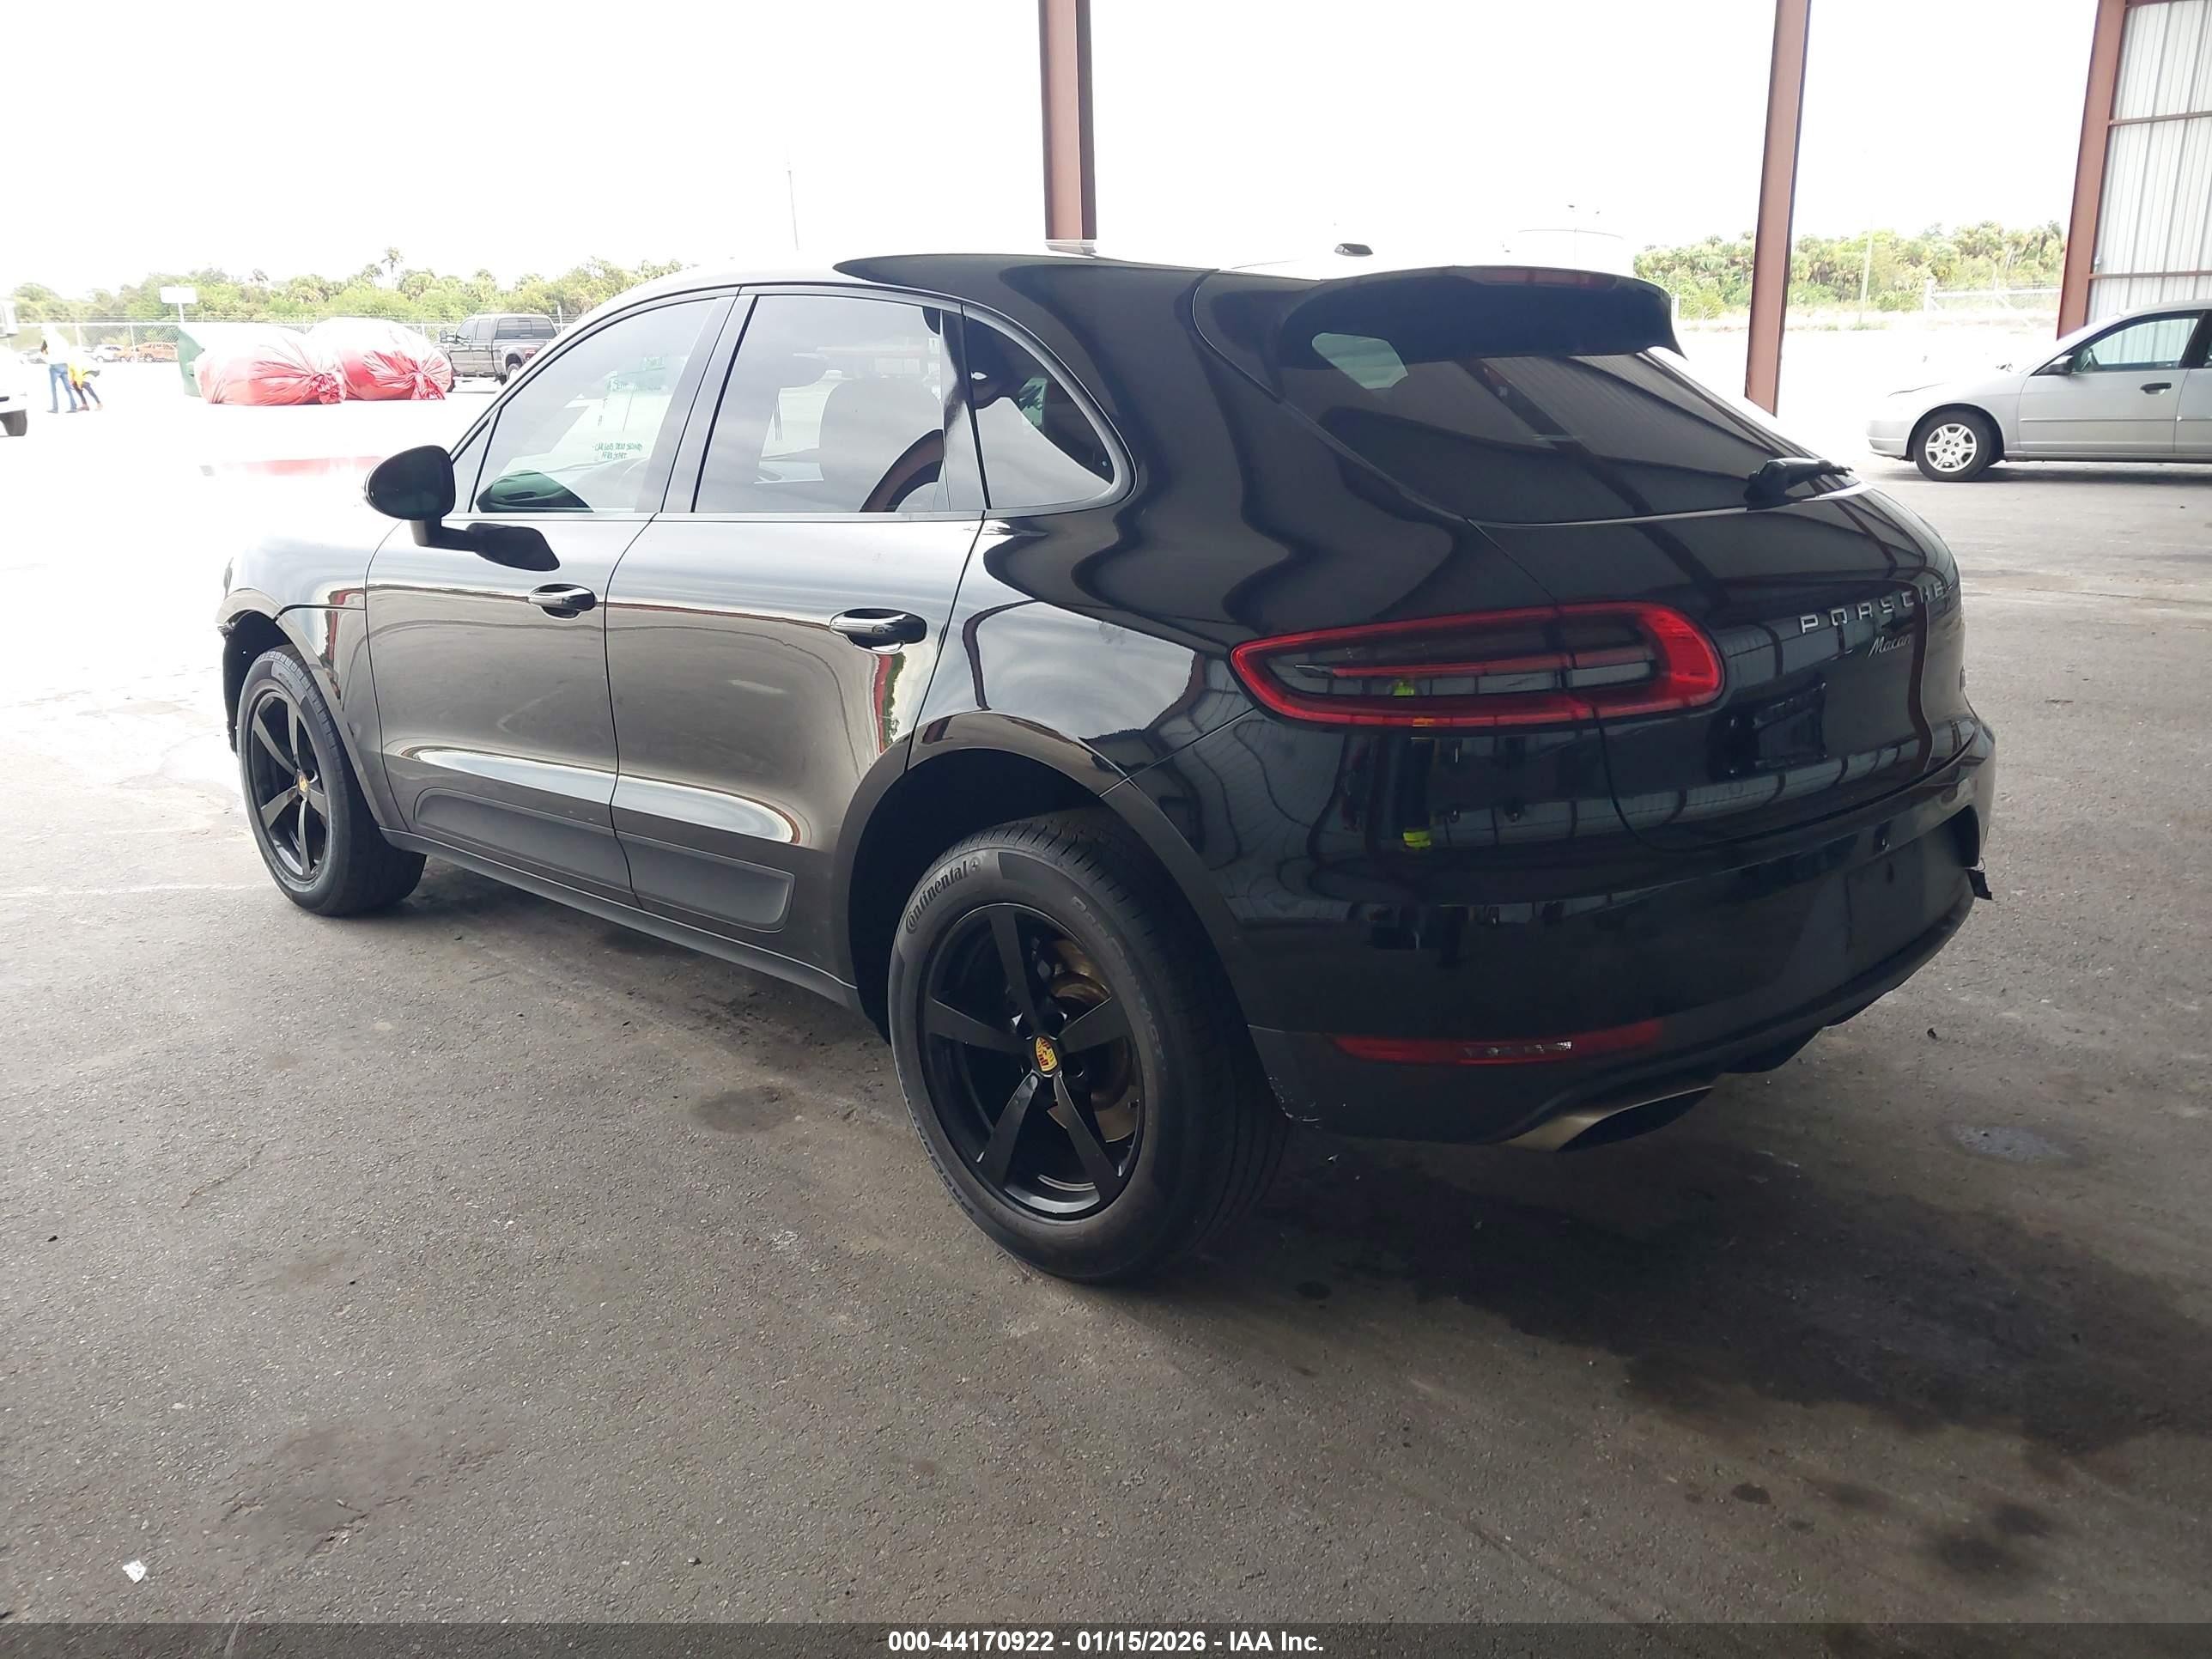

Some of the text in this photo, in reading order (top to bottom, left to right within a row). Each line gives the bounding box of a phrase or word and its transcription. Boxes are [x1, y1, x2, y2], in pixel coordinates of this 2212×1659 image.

[1799, 580, 1946, 635] PORSCHE
[1868, 635, 1911, 659] Macan
[905, 860, 969, 935] Continental
